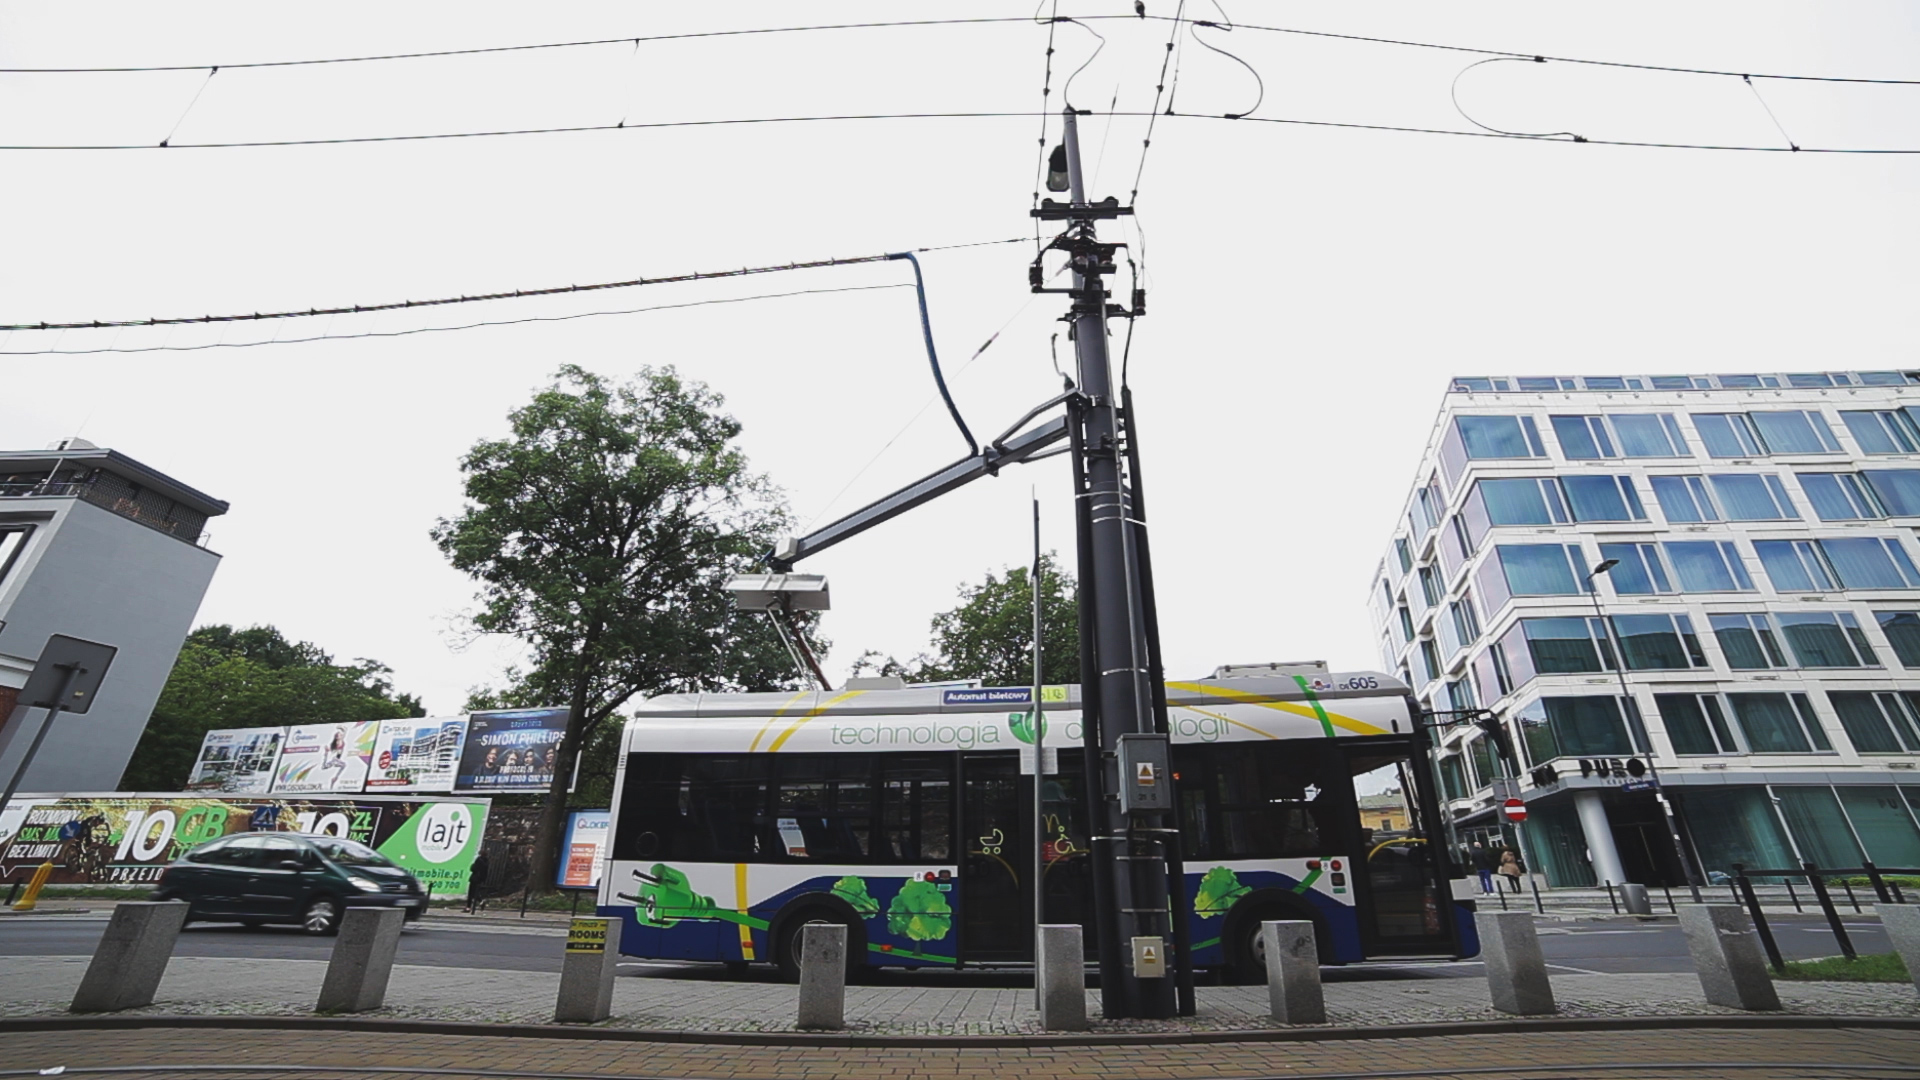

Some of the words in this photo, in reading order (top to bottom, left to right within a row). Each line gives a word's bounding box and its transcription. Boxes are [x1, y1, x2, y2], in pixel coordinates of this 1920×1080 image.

[947, 692, 986, 701] Automat
[989, 691, 1029, 701] biletowy
[831, 722, 1000, 749] technologia
[1168, 712, 1230, 743] logii
[480, 733, 517, 746] SIMON
[519, 731, 566, 745] PHILLIPS
[1579, 758, 1646, 779] PURO
[176, 806, 228, 843] GB
[423, 811, 466, 850] lajt
[7, 844, 29, 858] BEZ
[110, 868, 164, 881] PRZEJD
[569, 930, 605, 939] ROOMS
